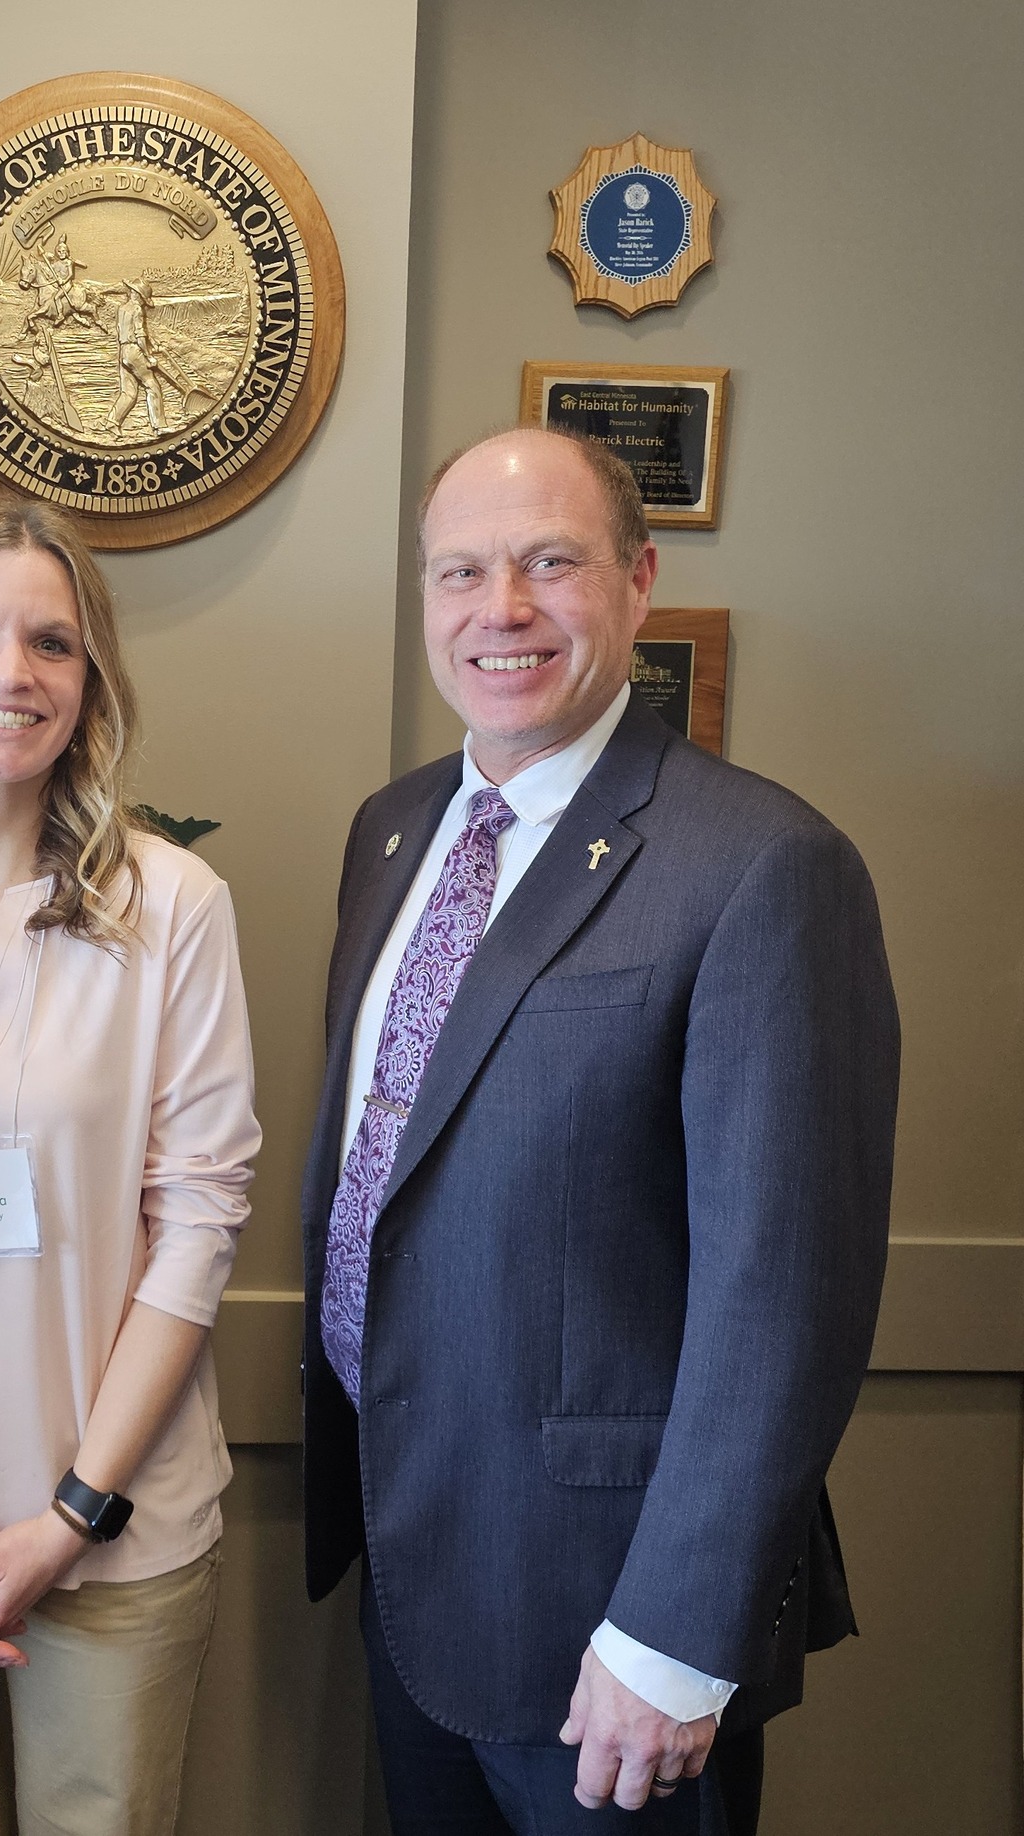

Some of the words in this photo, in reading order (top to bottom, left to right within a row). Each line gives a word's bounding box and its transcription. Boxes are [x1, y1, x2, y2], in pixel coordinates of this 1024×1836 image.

[50, 123, 137, 164] THE
[4, 145, 49, 189] OF
[141, 127, 252, 212] STATE
[115, 172, 147, 192] DU
[153, 182, 211, 229] NORD
[239, 202, 283, 256] OF
[617, 217, 635, 227] Jason
[176, 259, 299, 472] MINNESOTA
[579, 400, 619, 412] Habitat
[622, 400, 638, 412] for
[641, 401, 694, 416] Humanity
[608, 419, 637, 427] Presented
[625, 435, 665, 447] Electric
[91, 463, 162, 494] 1858
[633, 460, 667, 468] Leadership
[645, 477, 666, 485] Family
